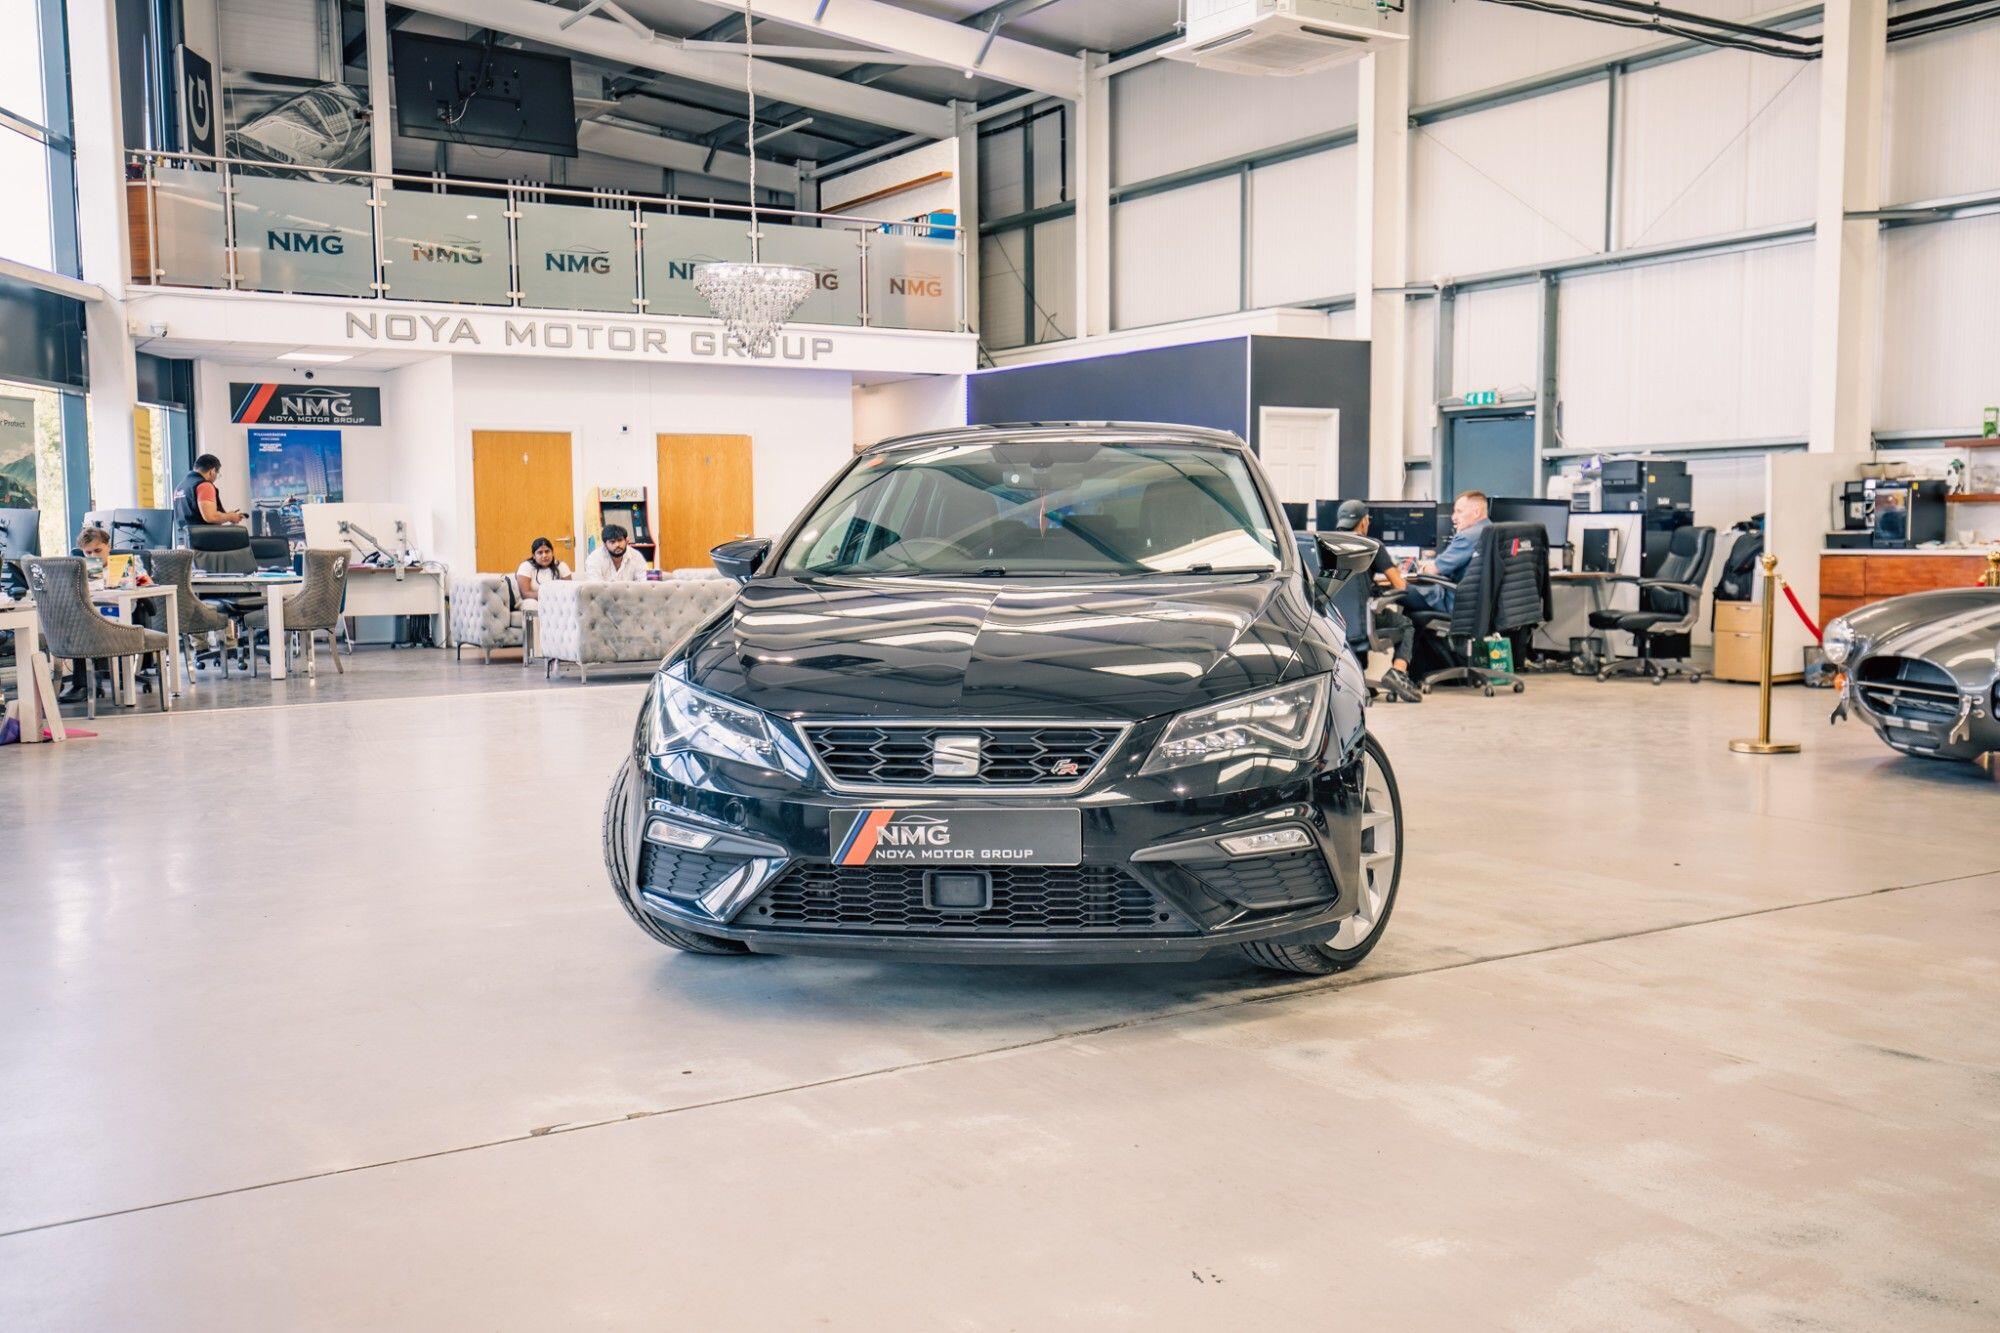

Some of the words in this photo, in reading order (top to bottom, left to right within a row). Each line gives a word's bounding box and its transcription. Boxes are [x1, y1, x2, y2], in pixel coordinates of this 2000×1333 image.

[267, 230, 344, 255] NMG
[412, 242, 483, 265] NMG
[545, 252, 611, 275] NMG
[889, 278, 942, 297] NMG
[345, 311, 481, 345] NOYA
[505, 319, 668, 354] MOTOR
[280, 396, 353, 417] NMG
[876, 825, 951, 846] NMG
[875, 849, 916, 859] NOYA
[921, 849, 975, 859] MOTOR
[981, 849, 1034, 859] GROUP
